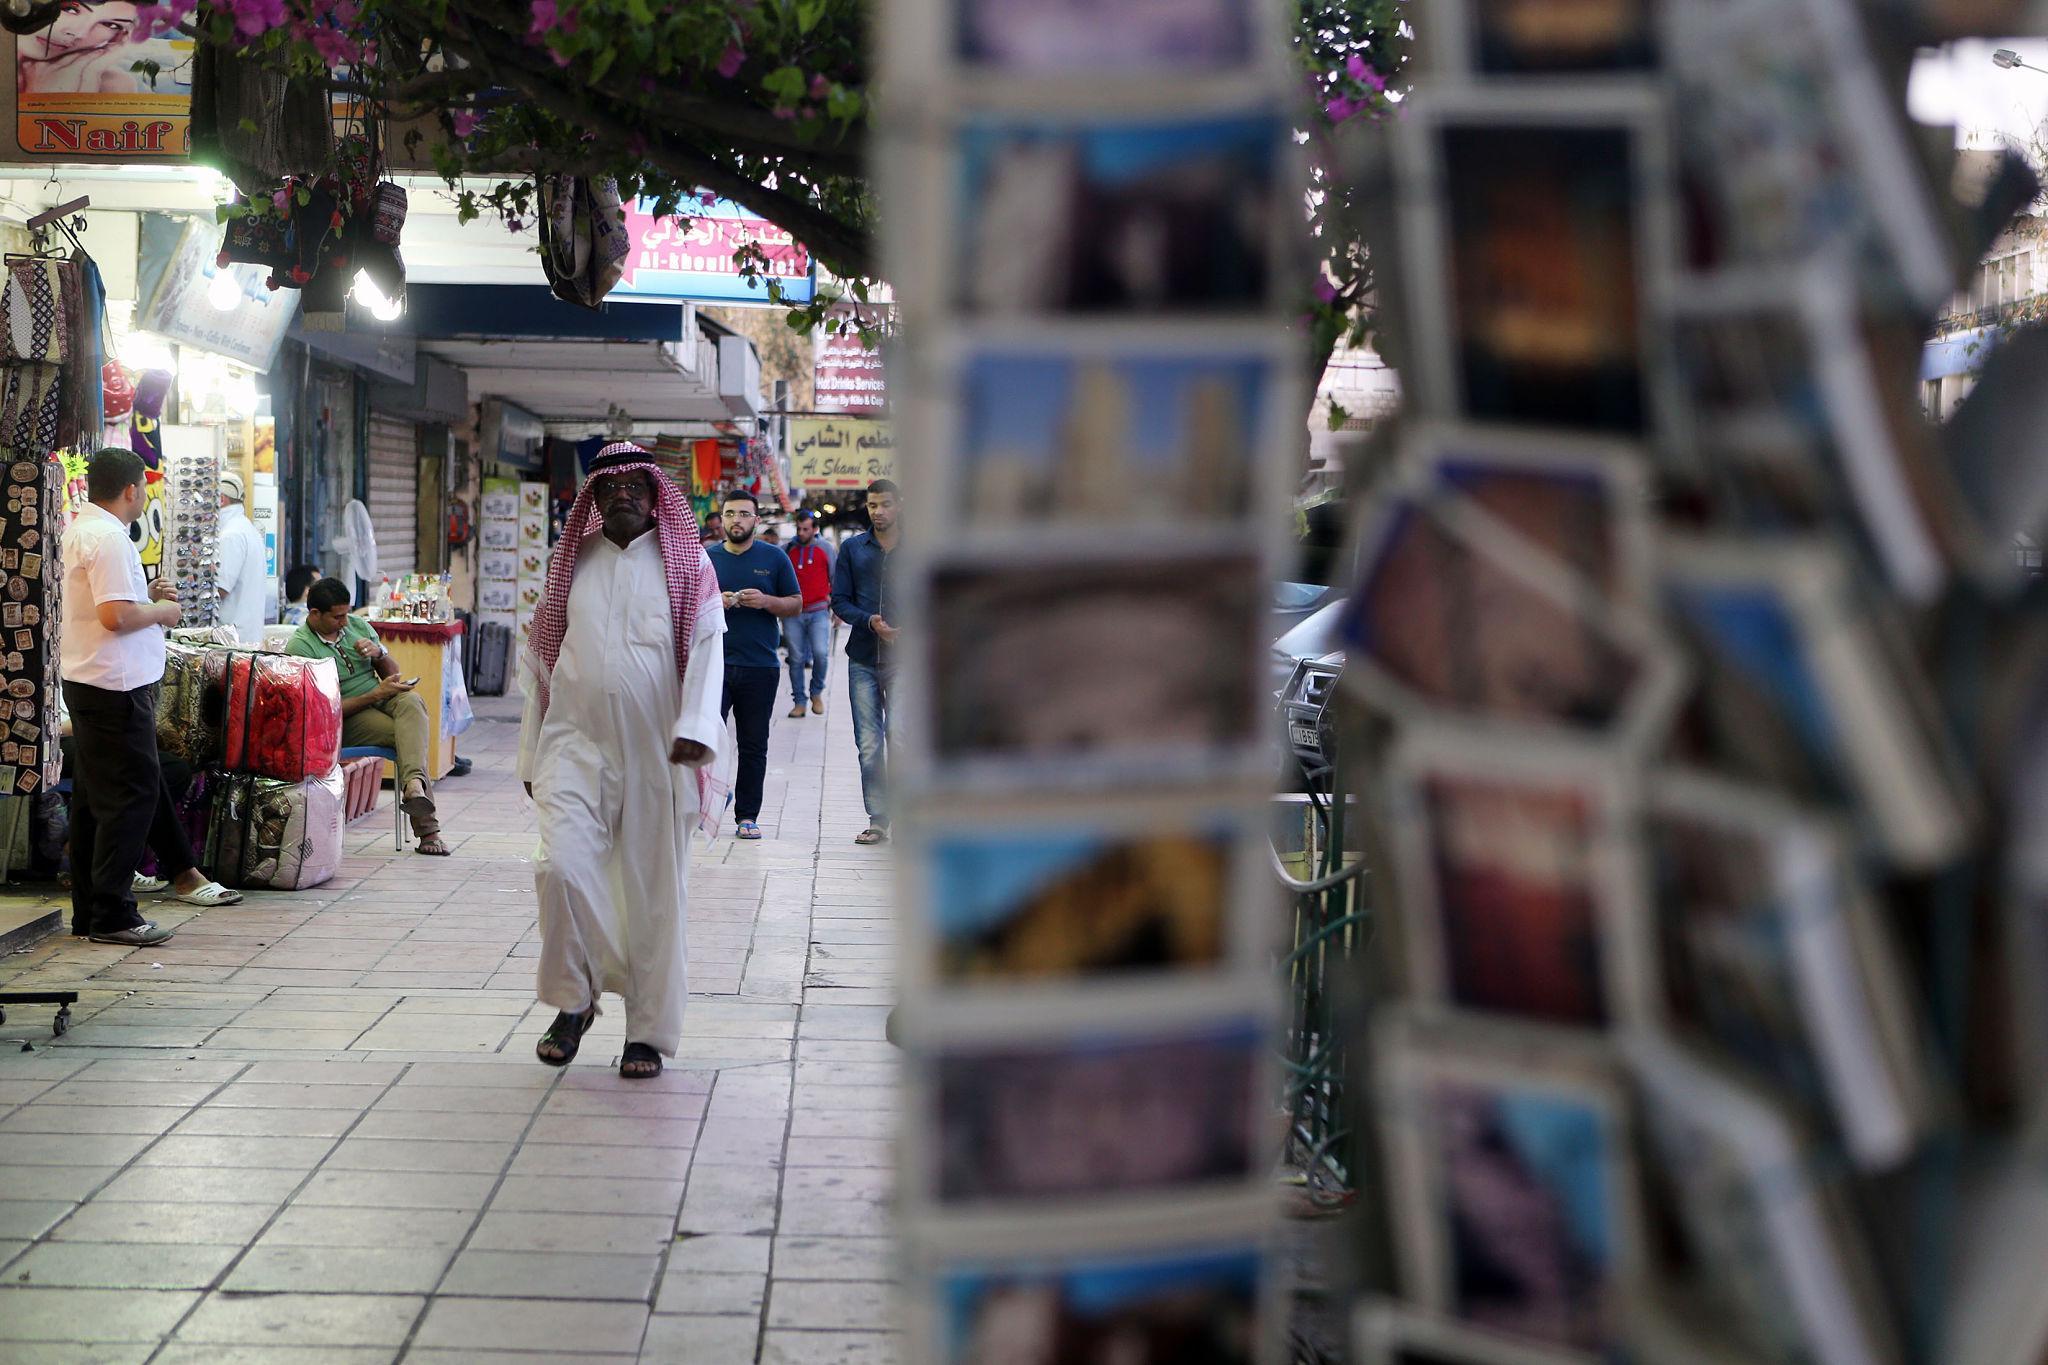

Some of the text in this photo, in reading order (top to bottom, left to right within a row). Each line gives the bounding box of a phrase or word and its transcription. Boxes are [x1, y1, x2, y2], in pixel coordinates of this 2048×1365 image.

[34, 119, 173, 151] Naif
[641, 219, 794, 249] فندق الخولي
[854, 376, 885, 391] Services
[795, 424, 850, 456] الشامي
[801, 457, 818, 475] Al
[821, 457, 862, 476] Shami
